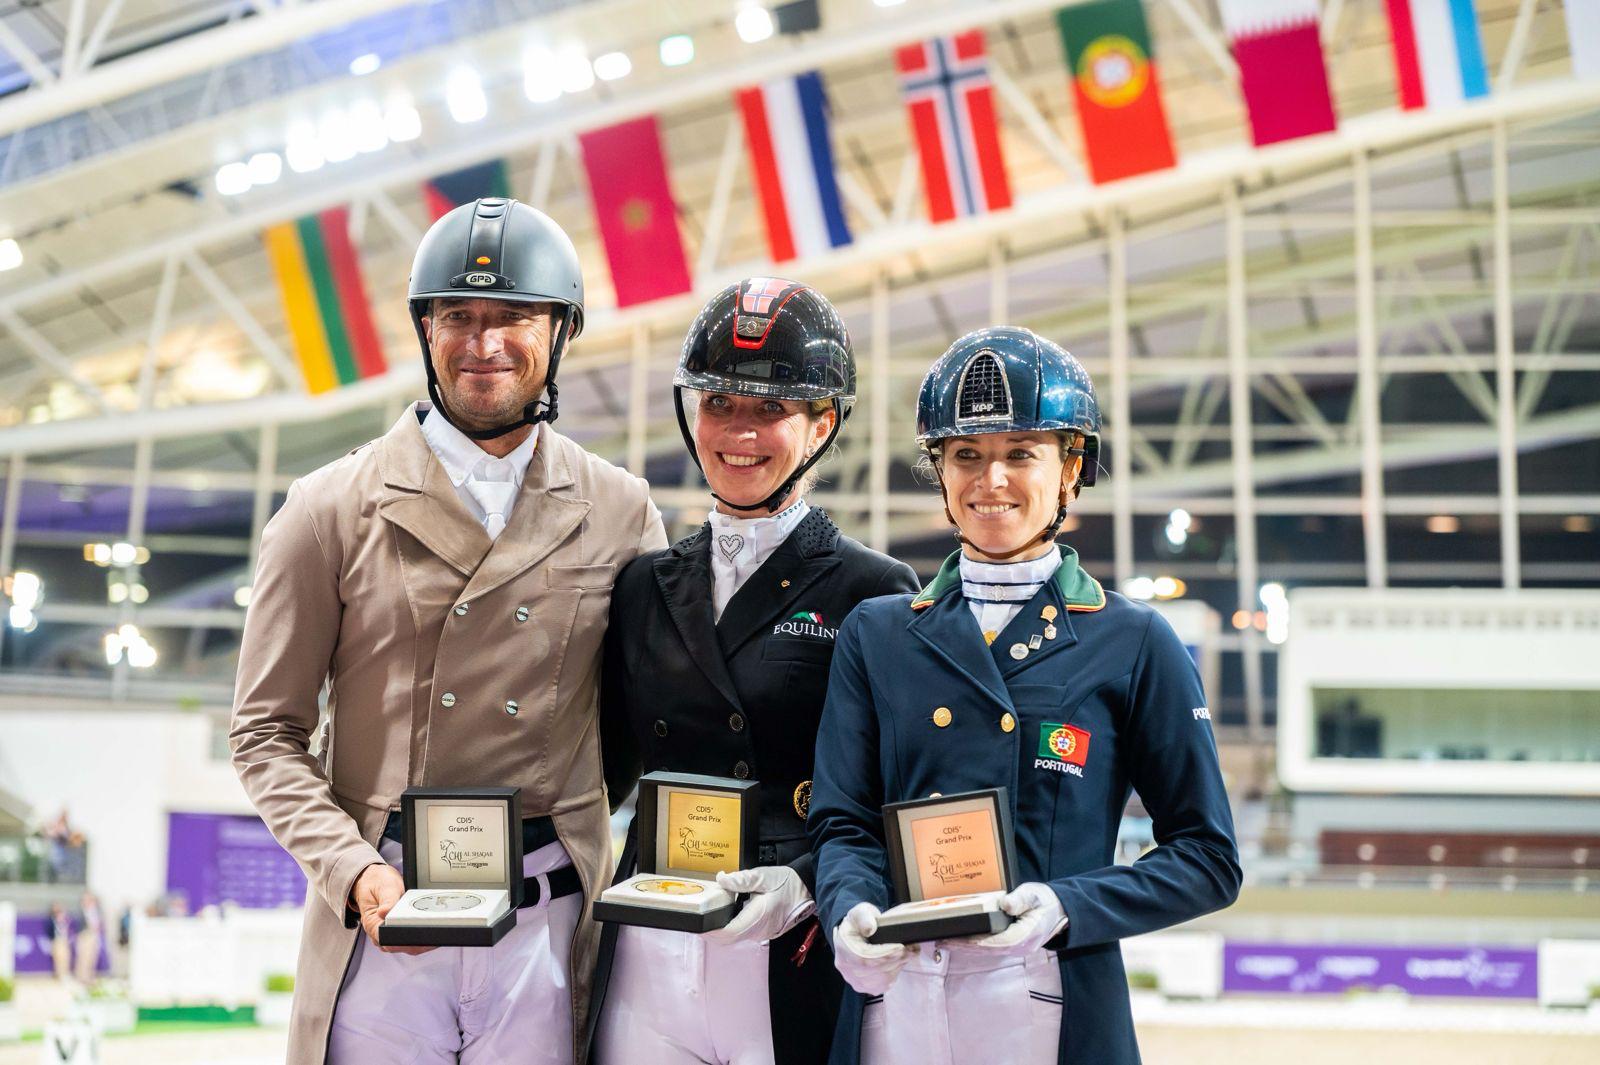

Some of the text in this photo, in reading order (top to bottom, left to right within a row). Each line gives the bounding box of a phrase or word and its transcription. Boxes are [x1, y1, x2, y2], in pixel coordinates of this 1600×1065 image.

[1033, 758, 1083, 778] PORTUGAL
[687, 813, 721, 823] Grand Prix
[448, 825, 469, 833] Grand
[935, 836, 957, 845] Grand
